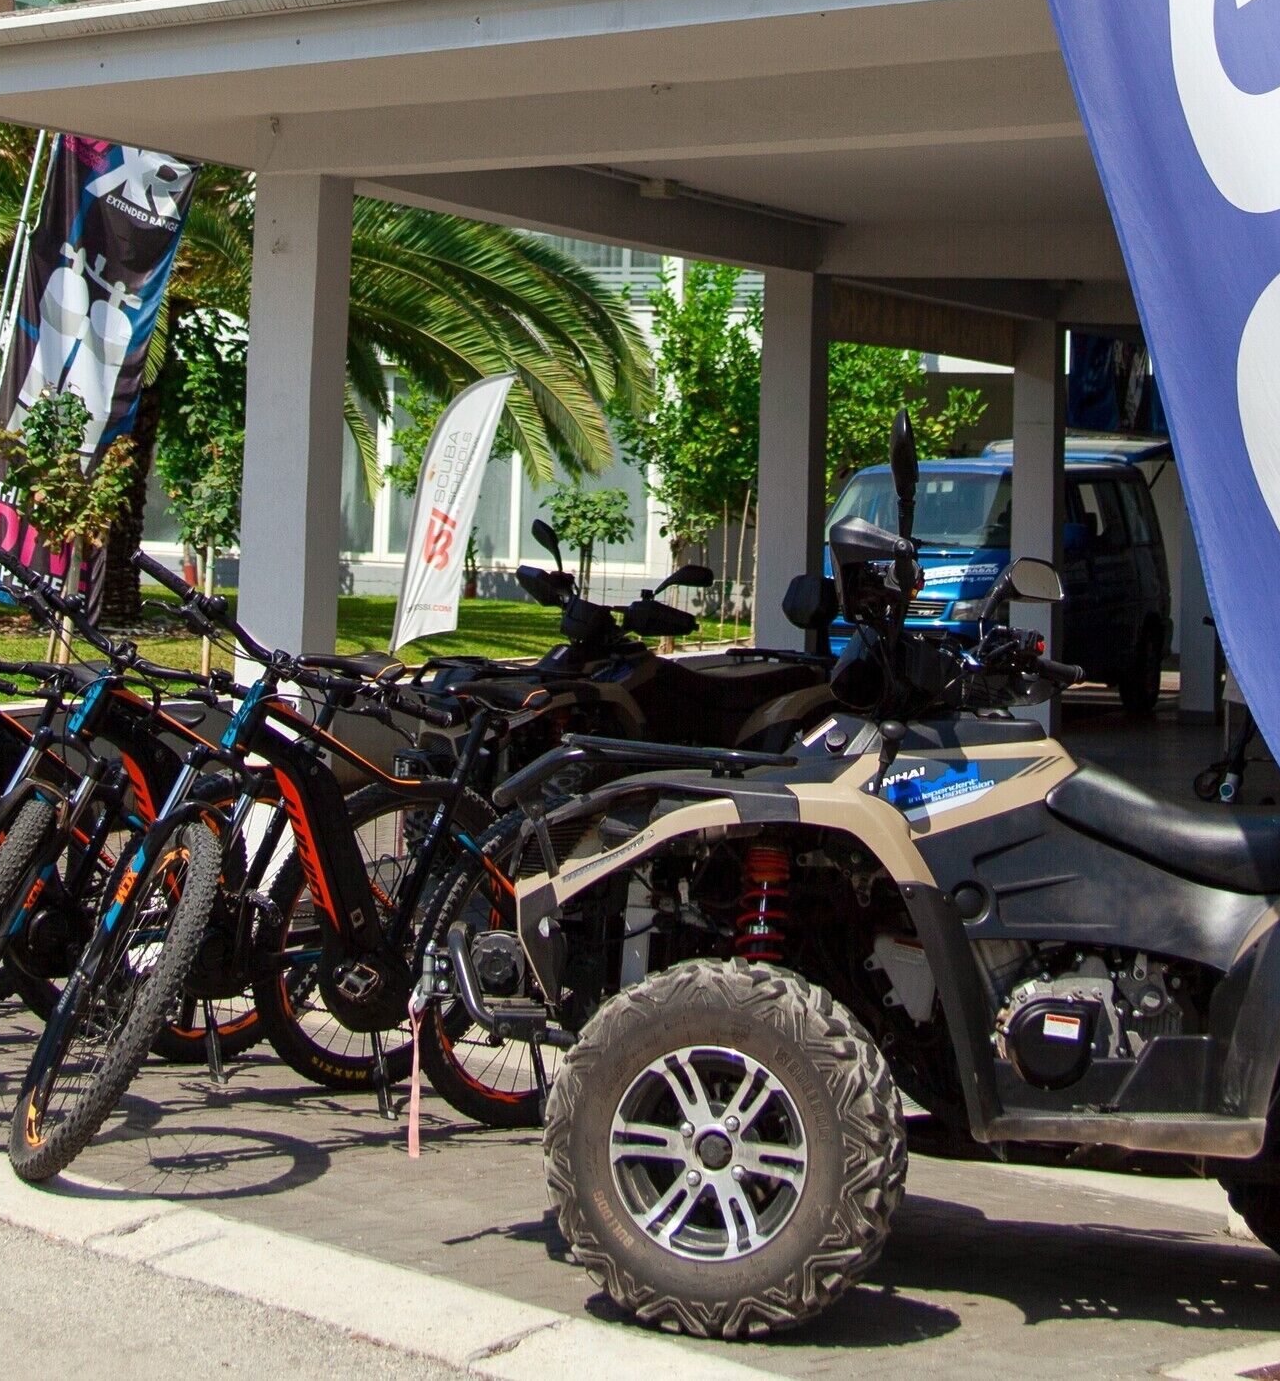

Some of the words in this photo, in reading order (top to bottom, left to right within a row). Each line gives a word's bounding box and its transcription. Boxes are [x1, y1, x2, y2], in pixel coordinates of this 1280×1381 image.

[106, 194, 149, 222] EXTENDED
[149, 213, 181, 234] RANGE
[434, 430, 461, 503] SCUBA
